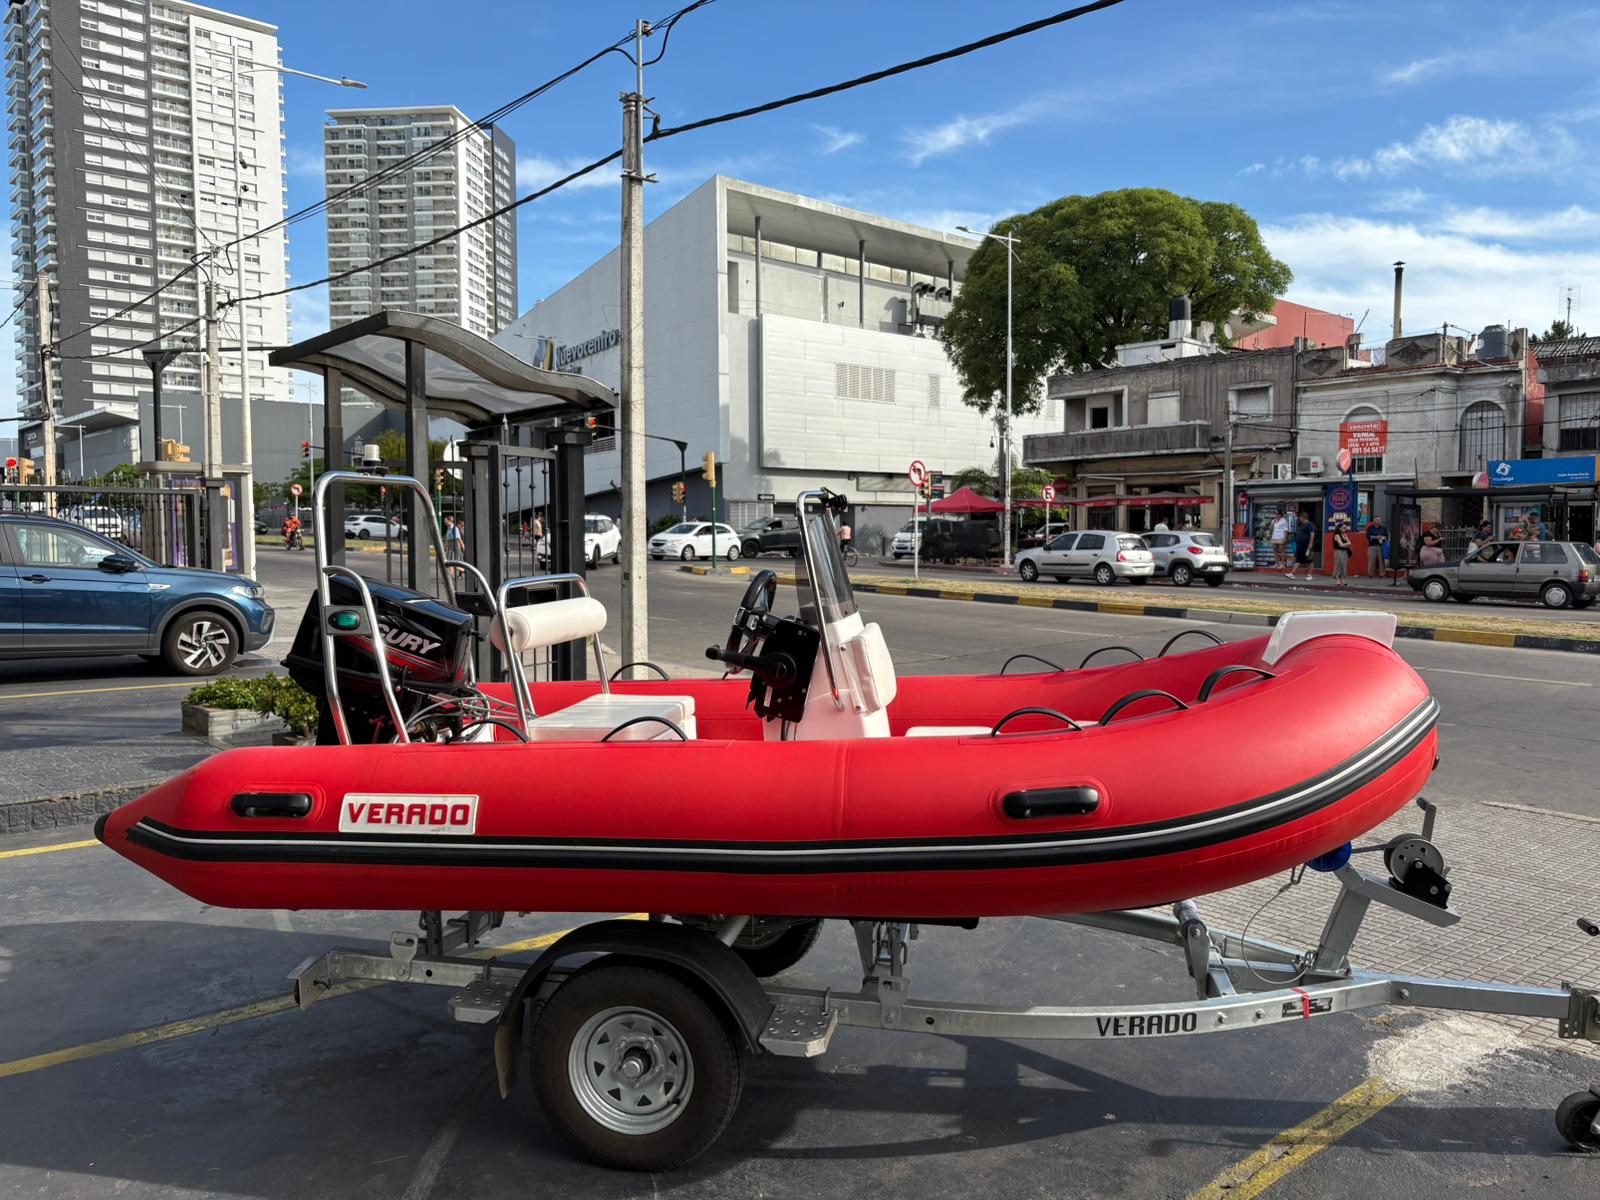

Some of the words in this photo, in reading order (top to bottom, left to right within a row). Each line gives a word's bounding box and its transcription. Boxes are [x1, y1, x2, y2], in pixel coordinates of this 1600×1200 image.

[378, 623, 441, 655] CURY
[348, 803, 470, 826] VERADO
[1096, 1012, 1198, 1037] VERADO
